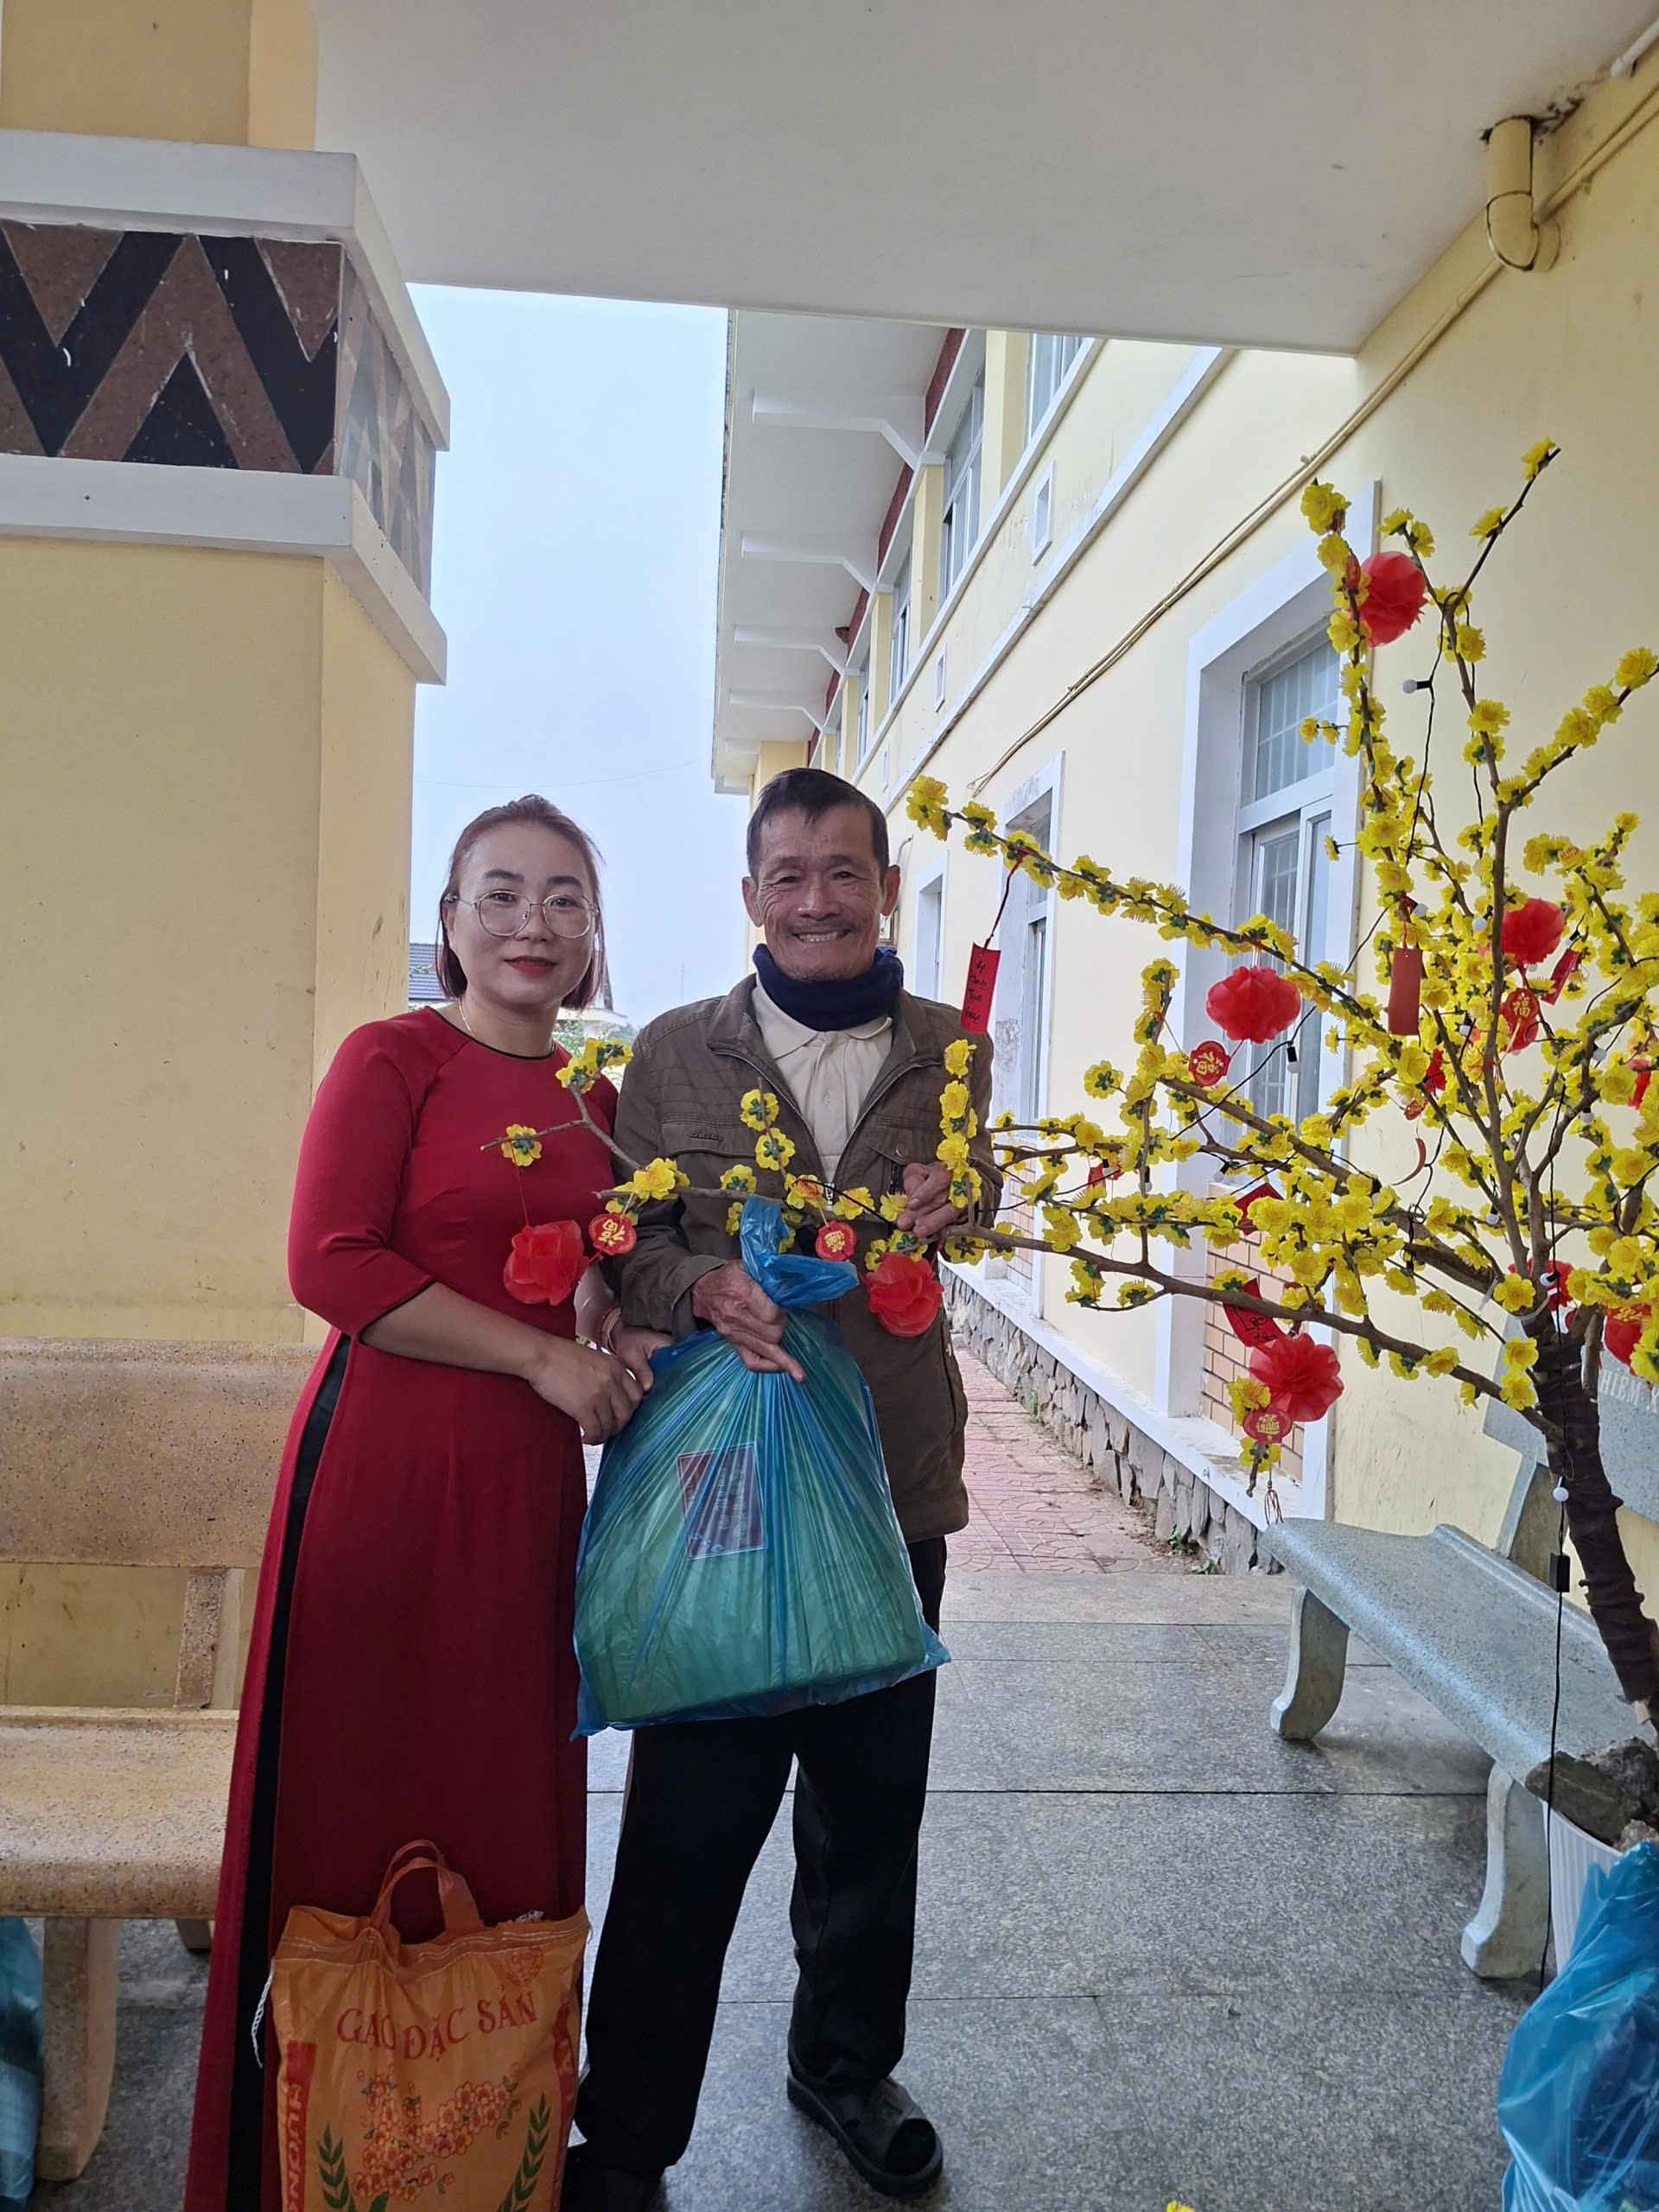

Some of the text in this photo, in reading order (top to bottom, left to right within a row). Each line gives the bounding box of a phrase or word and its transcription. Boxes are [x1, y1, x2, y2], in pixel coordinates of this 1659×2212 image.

[336, 1983, 537, 2063] GẠO ĐẶC SẢN
